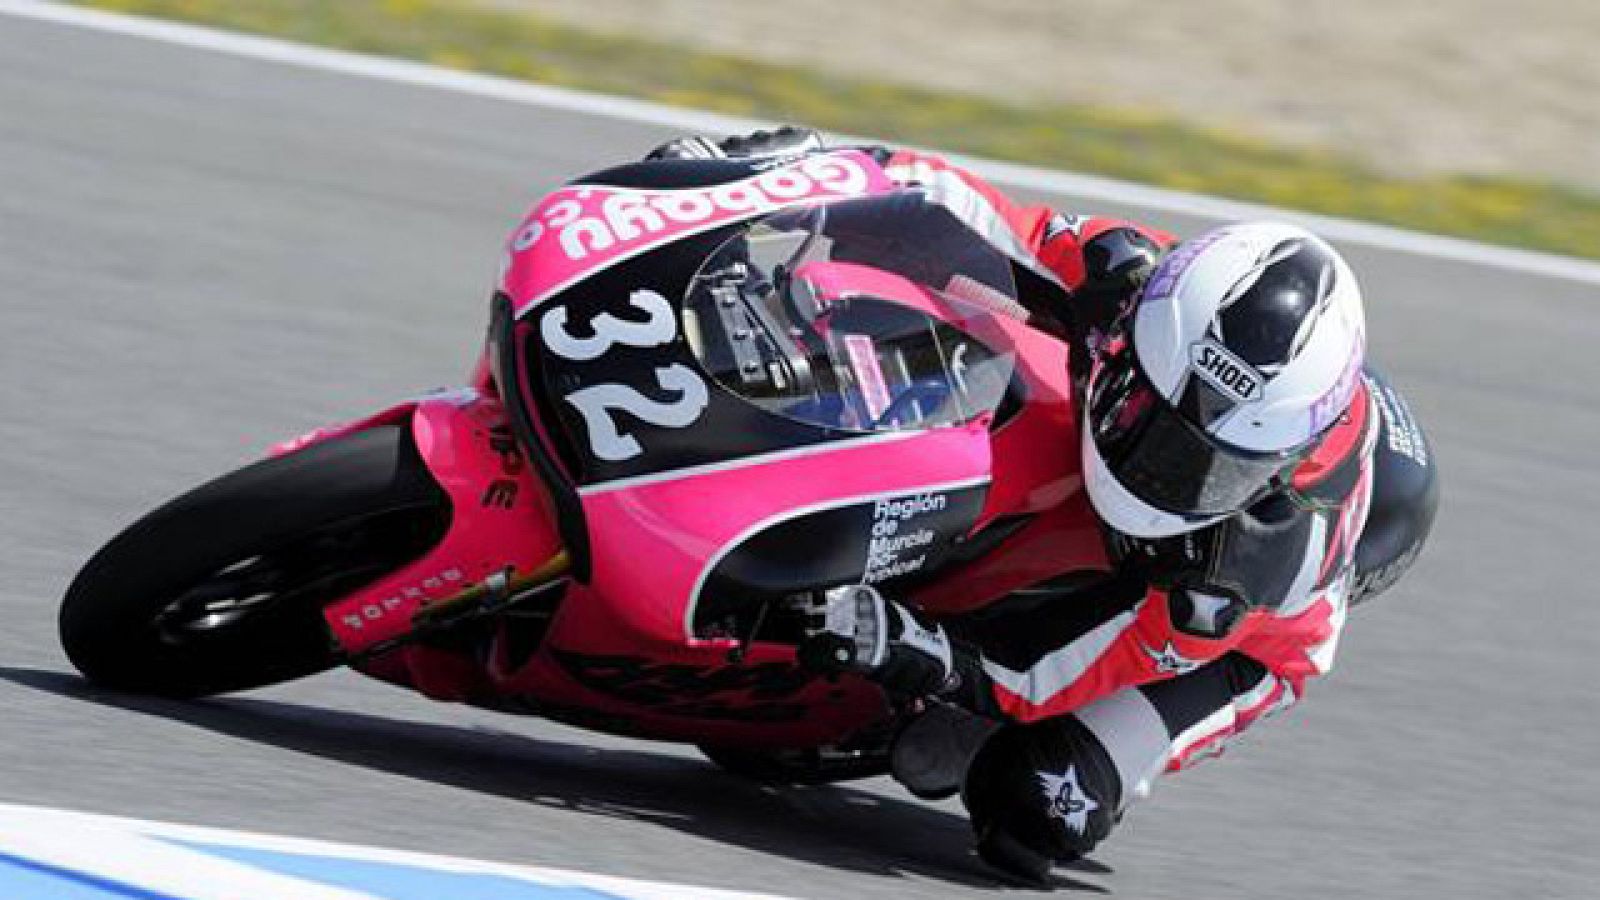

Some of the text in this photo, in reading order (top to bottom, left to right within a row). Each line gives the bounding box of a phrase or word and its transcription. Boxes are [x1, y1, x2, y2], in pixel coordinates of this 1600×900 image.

[559, 151, 868, 260] Gobayu
[540, 288, 710, 462] 32
[1196, 346, 1256, 400] SHOEI
